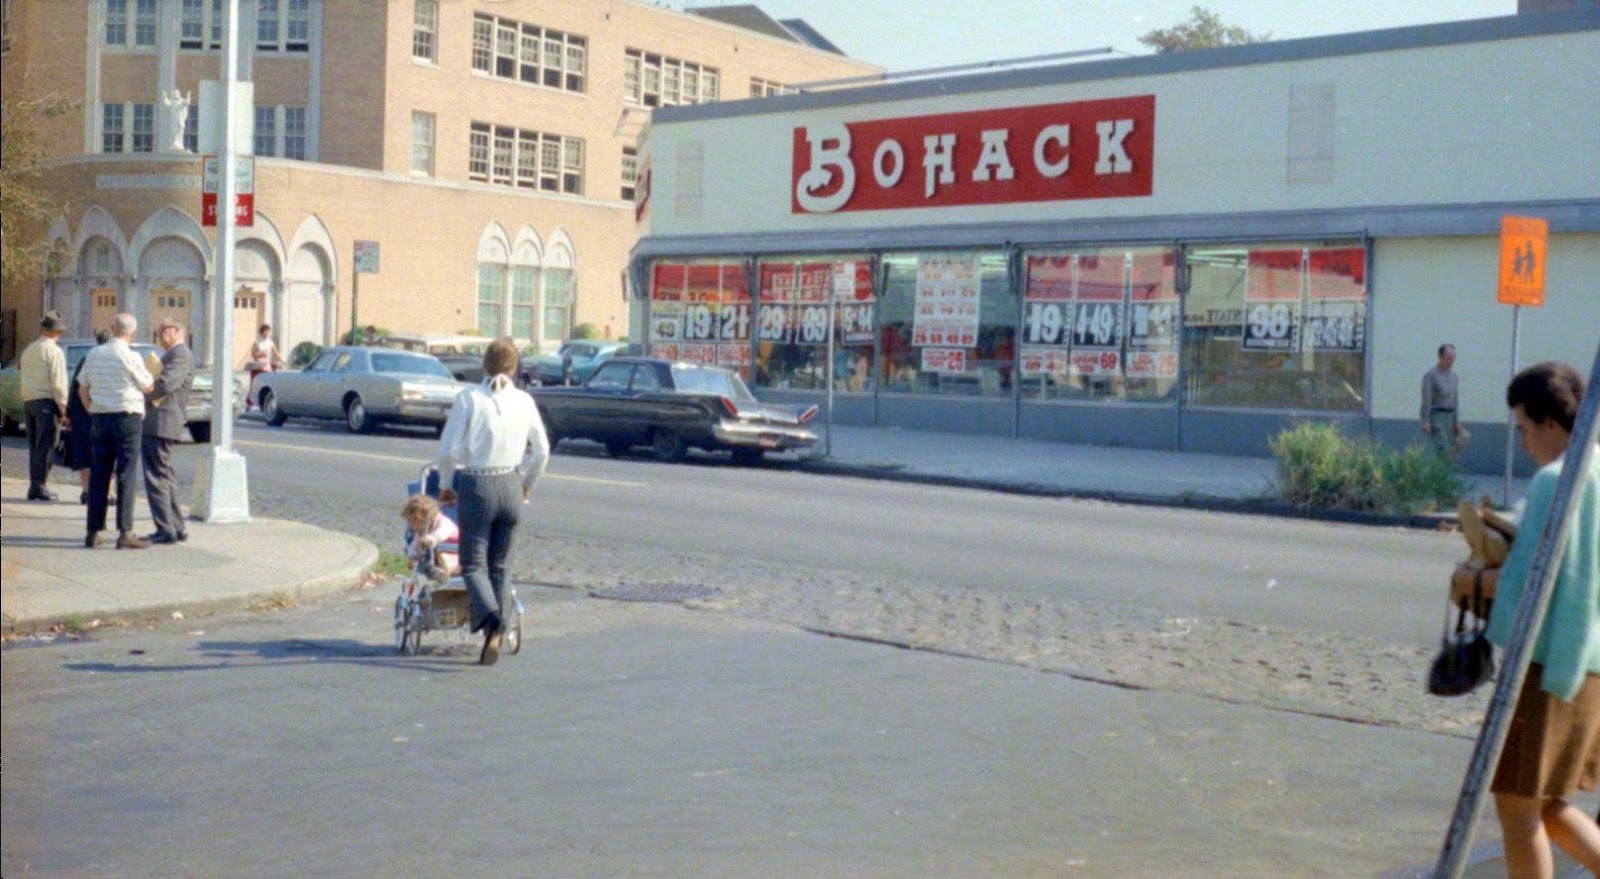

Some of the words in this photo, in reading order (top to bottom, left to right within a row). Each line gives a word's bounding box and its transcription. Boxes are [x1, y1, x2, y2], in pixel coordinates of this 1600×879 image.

[797, 118, 1134, 212] BOHACK
[686, 305, 712, 339] 19
[1027, 303, 1062, 342] 19
[1100, 352, 1117, 370] 69
